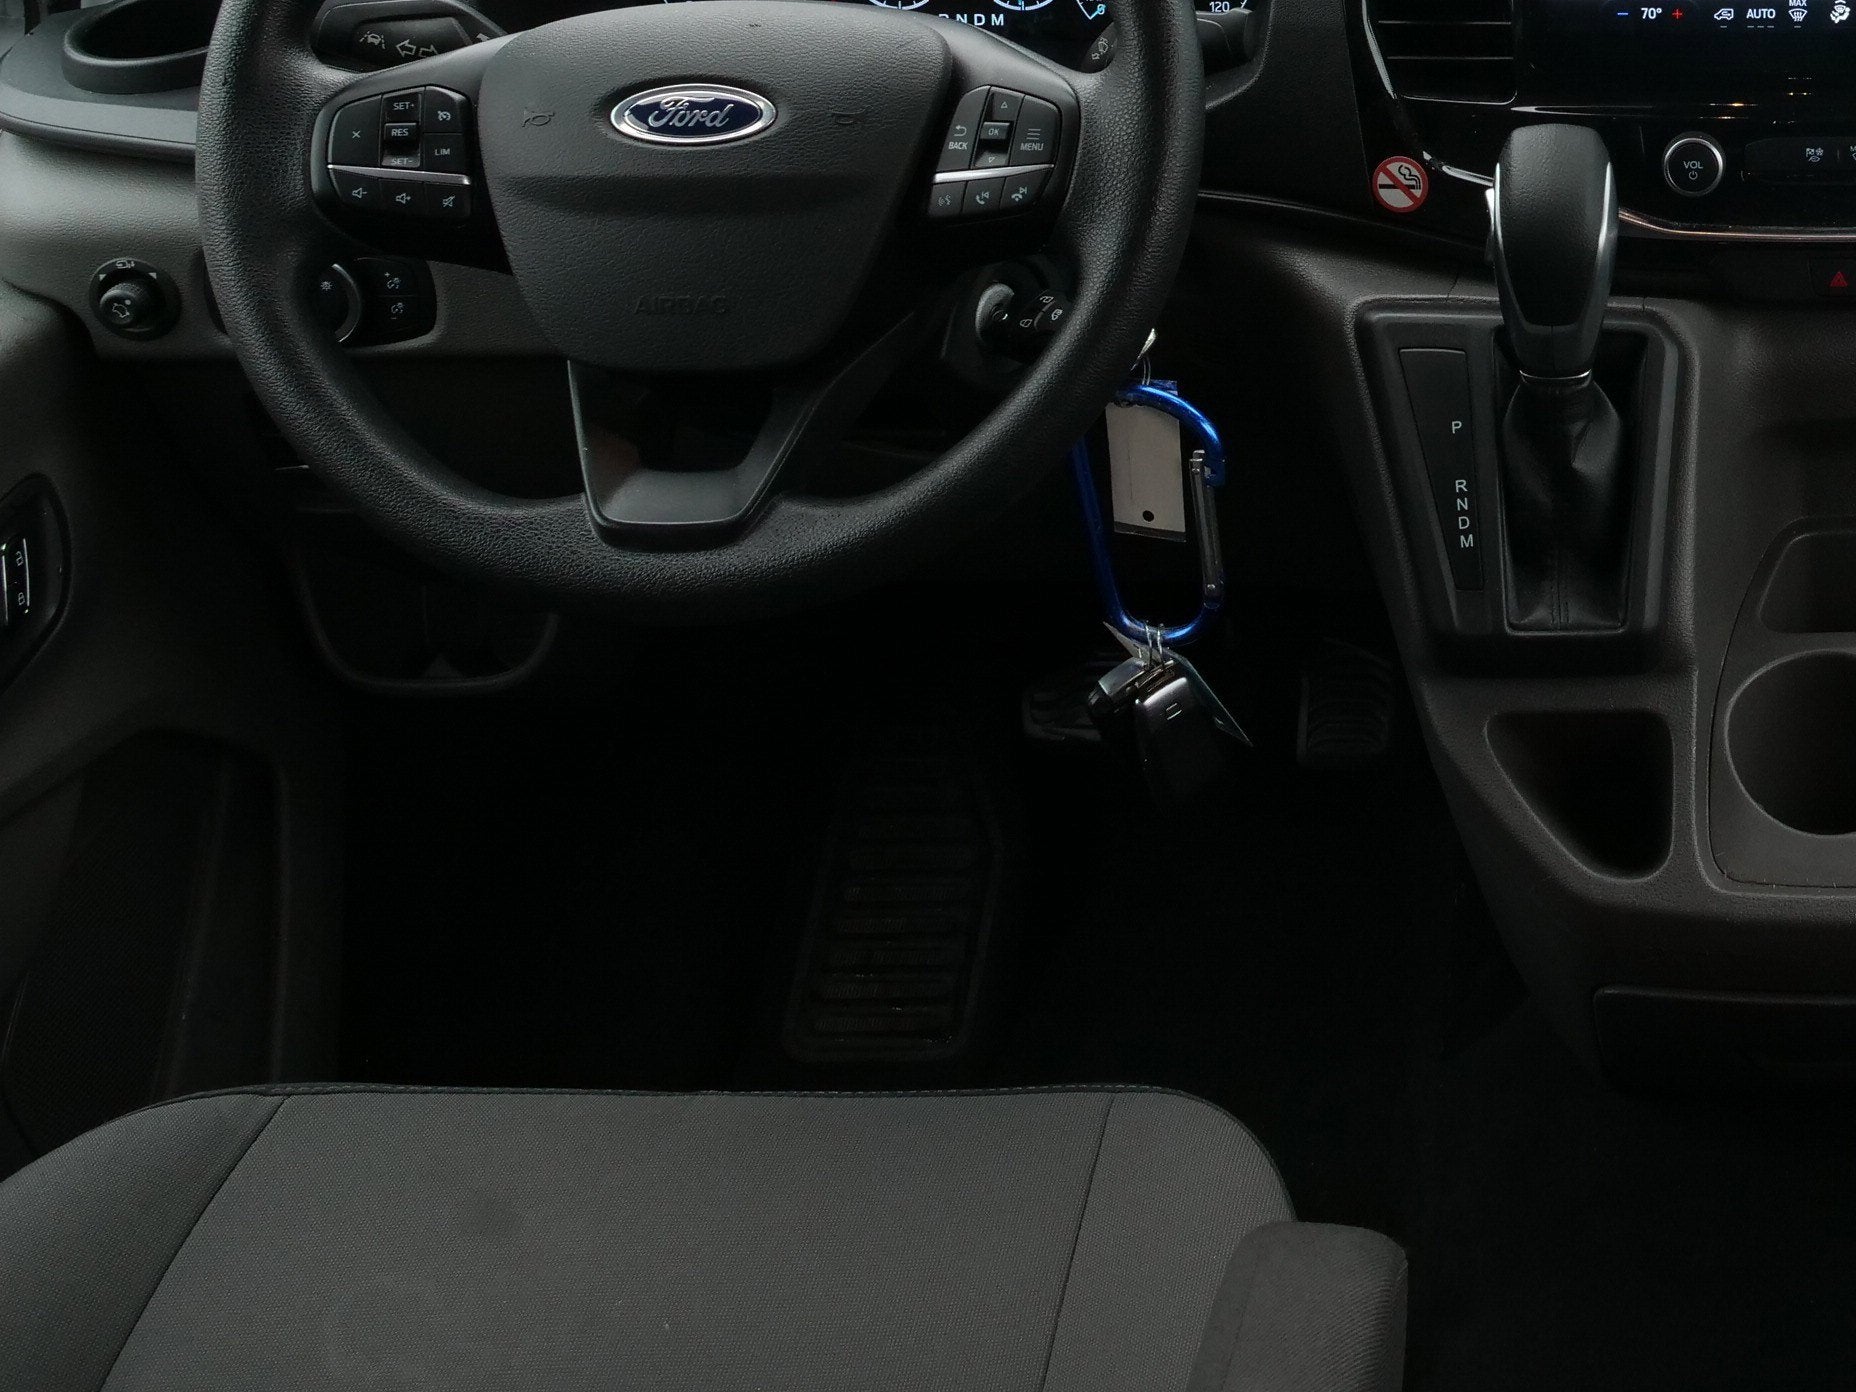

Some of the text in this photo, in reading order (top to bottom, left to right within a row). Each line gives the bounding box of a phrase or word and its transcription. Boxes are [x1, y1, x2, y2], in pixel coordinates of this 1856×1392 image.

[1209, 1, 1230, 13] 120
[1640, 7, 1663, 19] 70°
[973, 13, 986, 26] D
[990, 13, 1004, 26] M
[1746, 8, 1776, 19] AUTO
[648, 96, 735, 128] Ford
[391, 128, 409, 137] RES
[988, 128, 1001, 136] OK
[434, 147, 451, 156] LIM
[948, 141, 968, 150] BACK
[1020, 142, 1045, 151] MENU
[1683, 161, 1703, 170] VOL
[1451, 420, 1462, 434] P
[1455, 479, 1468, 493] R
[1456, 497, 1469, 511] N
[1458, 516, 1470, 529] D
[1460, 533, 1474, 548] M
